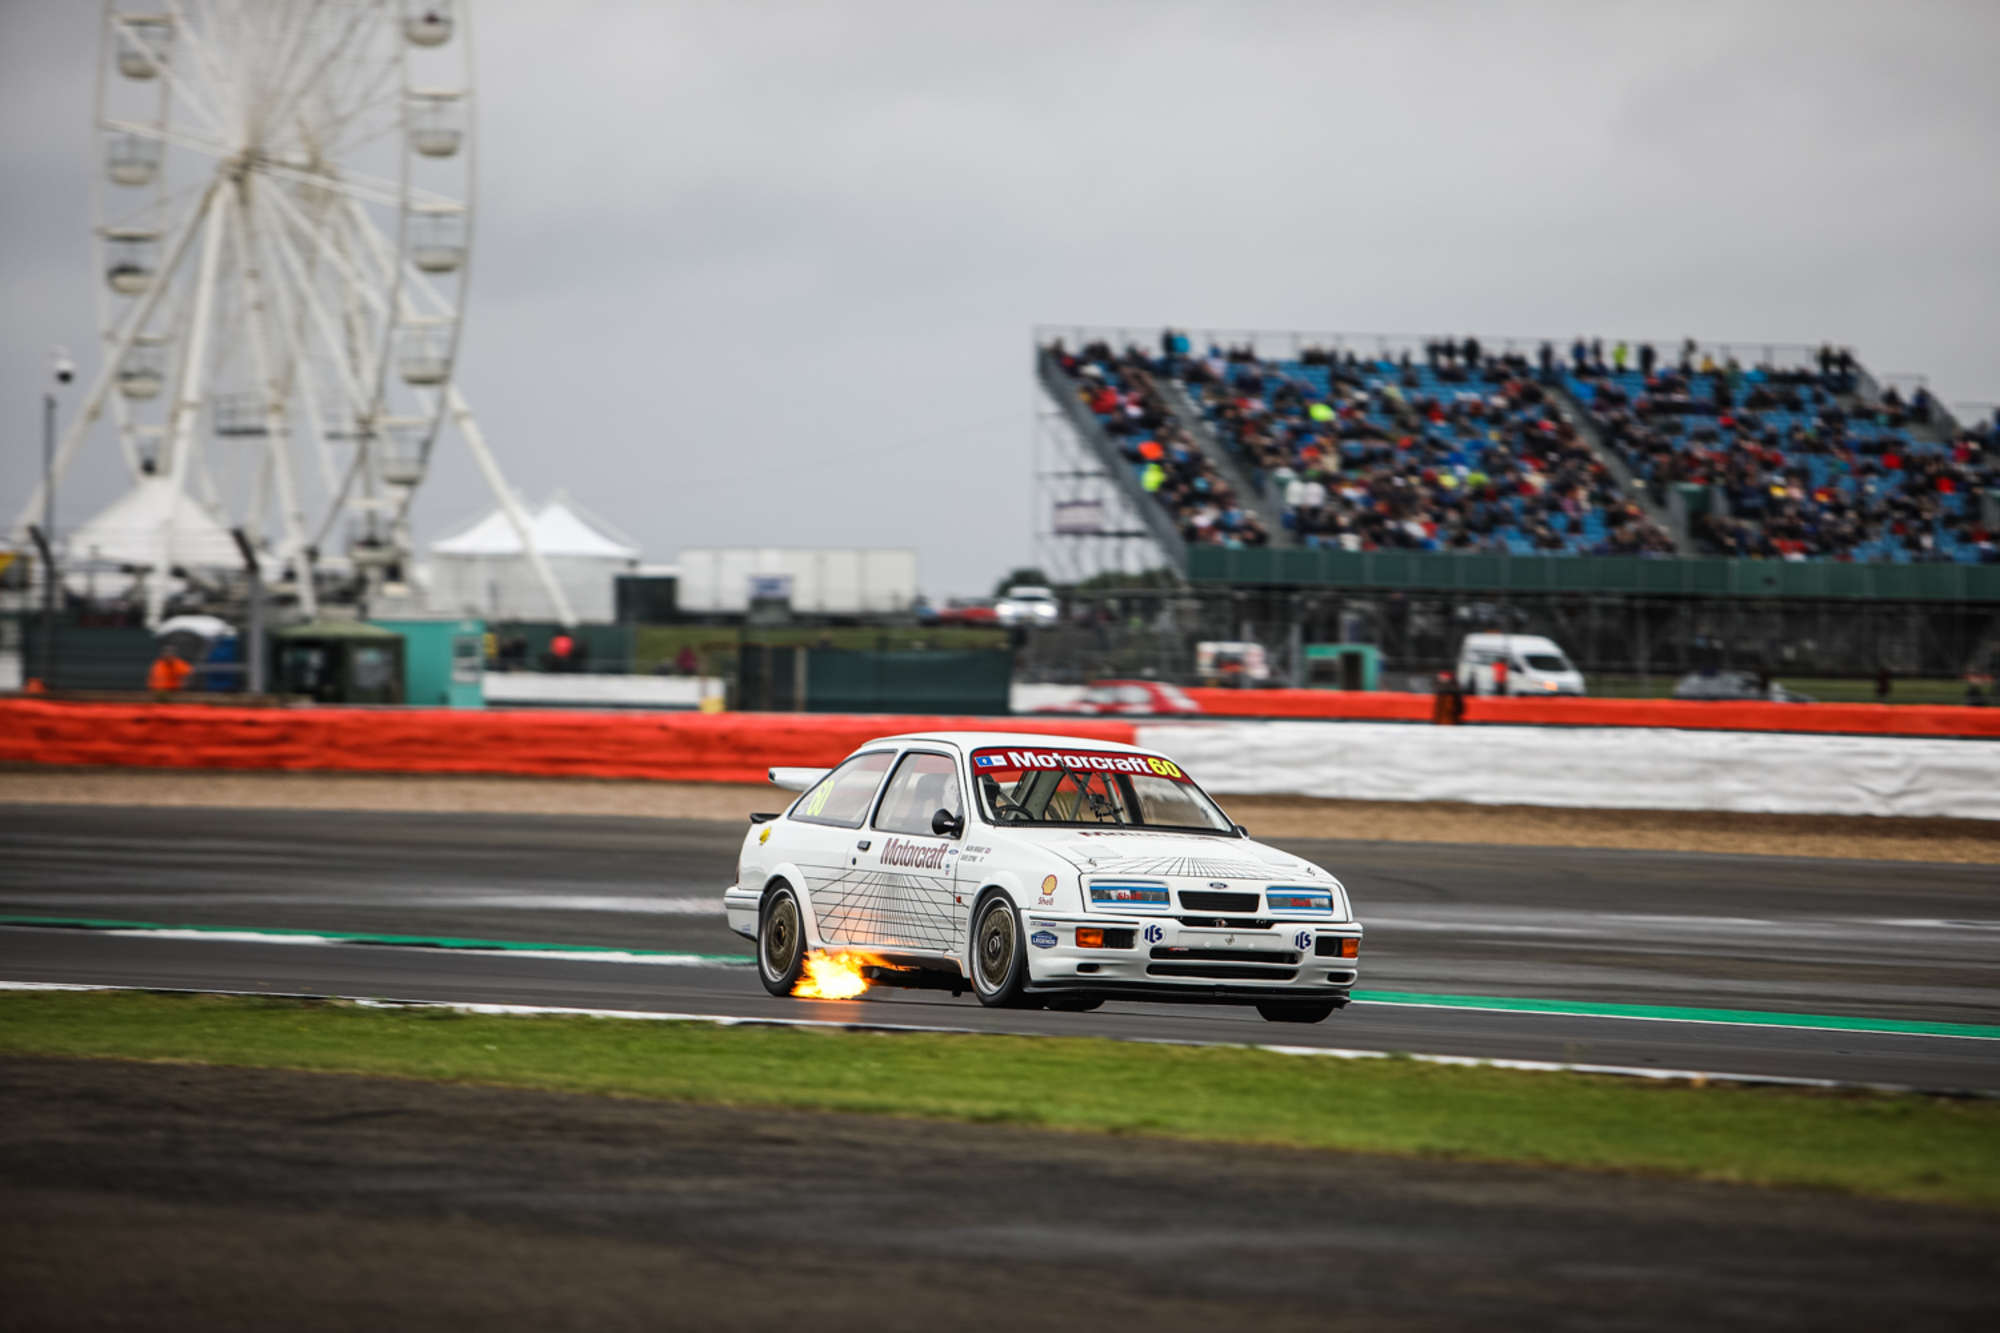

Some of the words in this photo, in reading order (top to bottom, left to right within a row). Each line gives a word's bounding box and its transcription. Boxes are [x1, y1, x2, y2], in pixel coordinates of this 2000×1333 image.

[1008, 751, 1152, 773] Motorcraft
[1147, 757, 1182, 779] 60
[880, 838, 949, 870] Motorcraft
[1037, 896, 1054, 906] Shell
[1117, 889, 1144, 900] Shell
